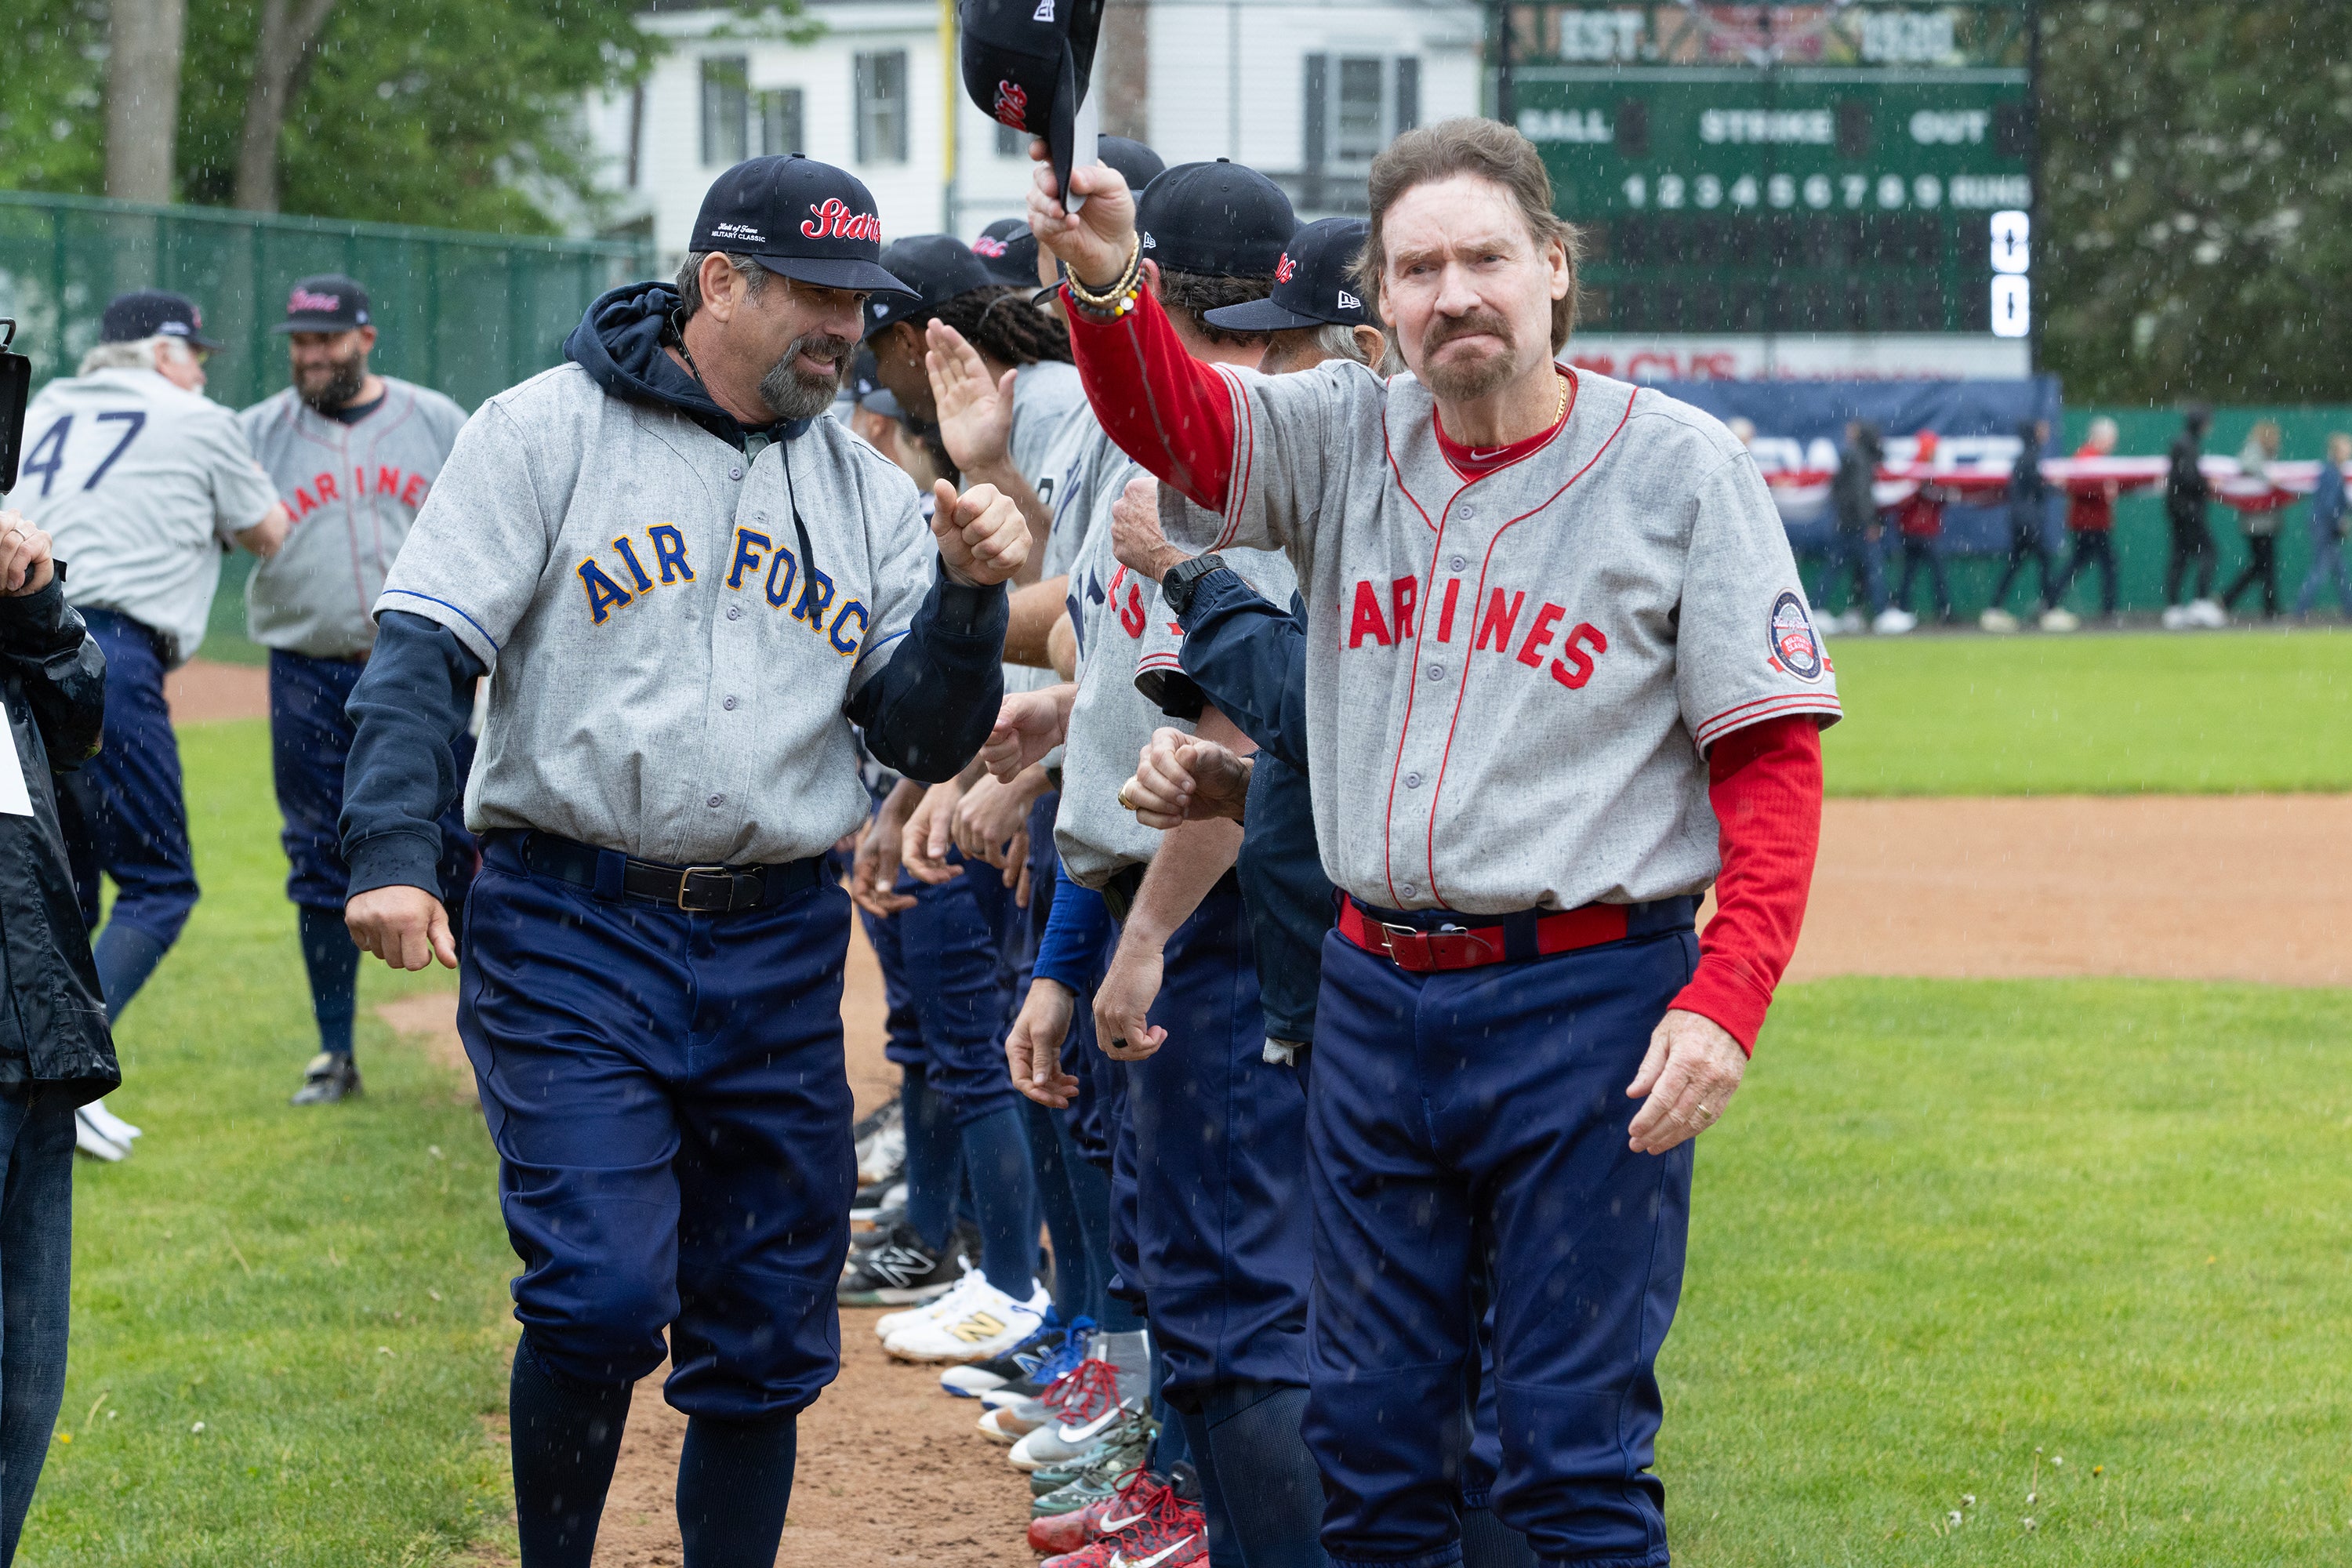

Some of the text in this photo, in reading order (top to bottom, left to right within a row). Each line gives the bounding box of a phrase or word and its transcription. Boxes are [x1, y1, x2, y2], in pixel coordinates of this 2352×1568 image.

[1561, 9, 1660, 61] EST.
[1518, 108, 1990, 145] BALL STRIKE OUT
[1621, 173, 2032, 209] 1 2 3 4 5 6 7 8 9 RUNS
[711, 230, 766, 243] MILITARY CLASSIC
[23, 412, 147, 498] 47
[280, 465, 430, 523] ARINE
[575, 523, 870, 671] AIR FORC
[1337, 575, 1608, 690] ARINES
